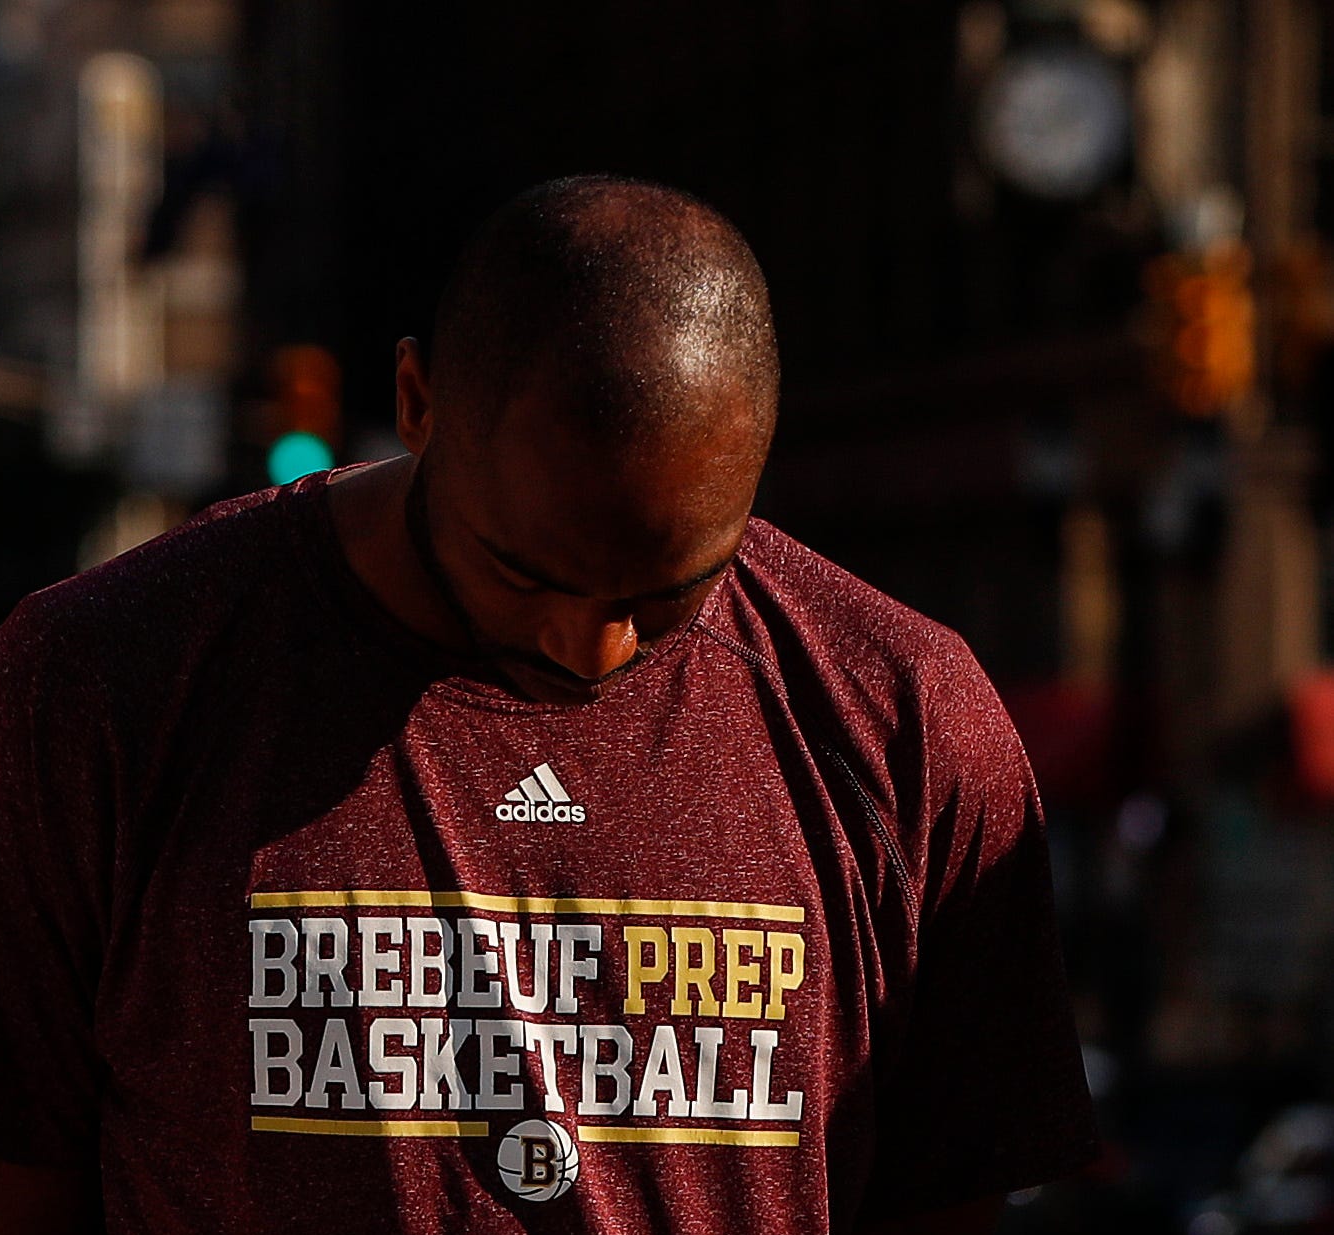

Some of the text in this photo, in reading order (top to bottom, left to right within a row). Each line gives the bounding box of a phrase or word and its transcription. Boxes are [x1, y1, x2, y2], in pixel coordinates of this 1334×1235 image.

[495, 799, 586, 823] adidas
[248, 916, 805, 1020] BREBEUF PREP
[248, 1018, 803, 1121] BASKETBALL
[520, 1135, 557, 1189] B
